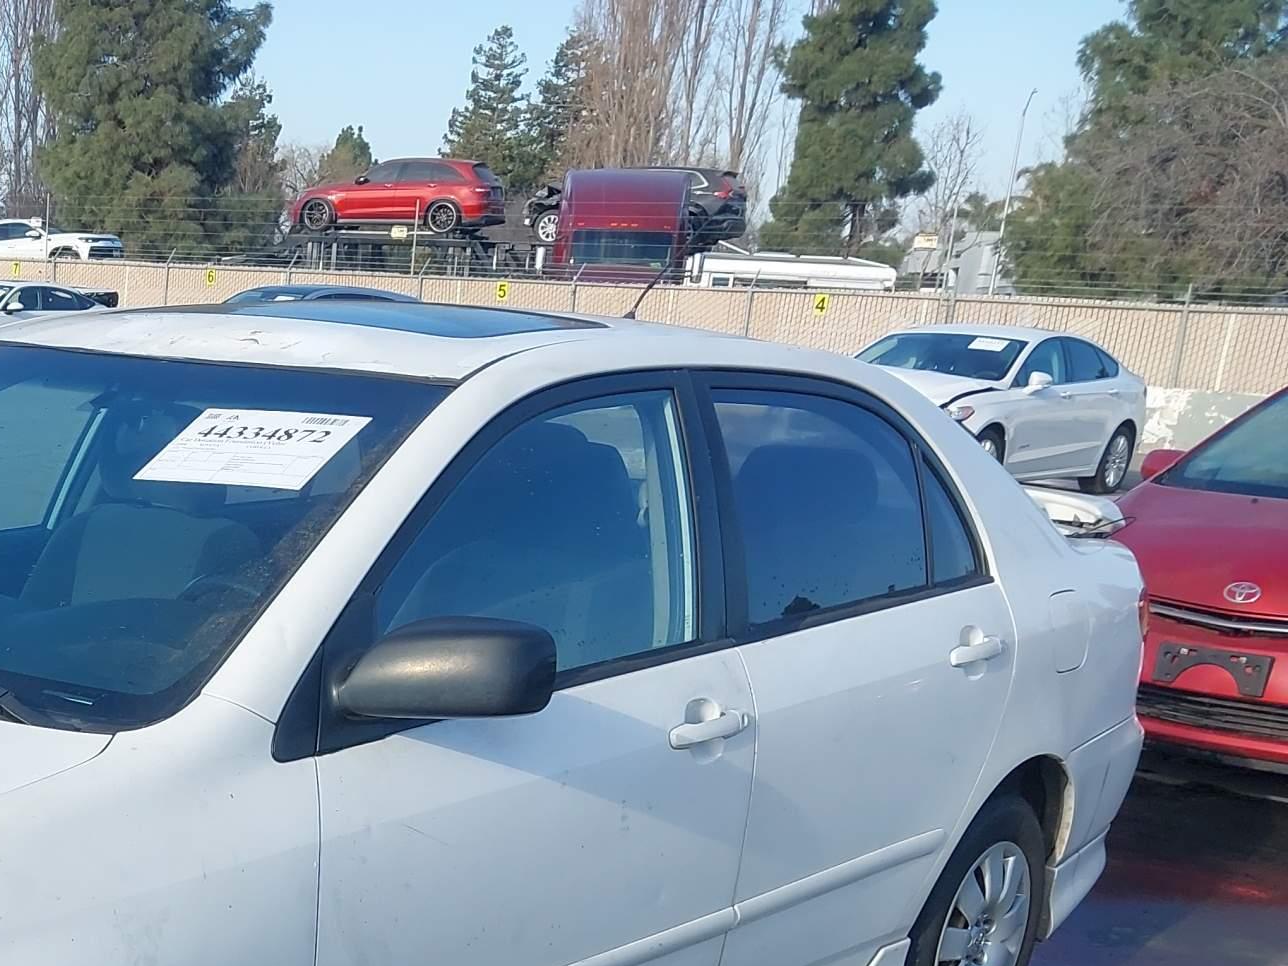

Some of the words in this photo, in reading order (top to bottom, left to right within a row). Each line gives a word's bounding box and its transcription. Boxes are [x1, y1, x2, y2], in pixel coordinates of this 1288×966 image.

[207, 270, 214, 283] 6
[497, 283, 507, 299] 5
[815, 296, 826, 313] 4
[197, 424, 332, 443] 44334872
